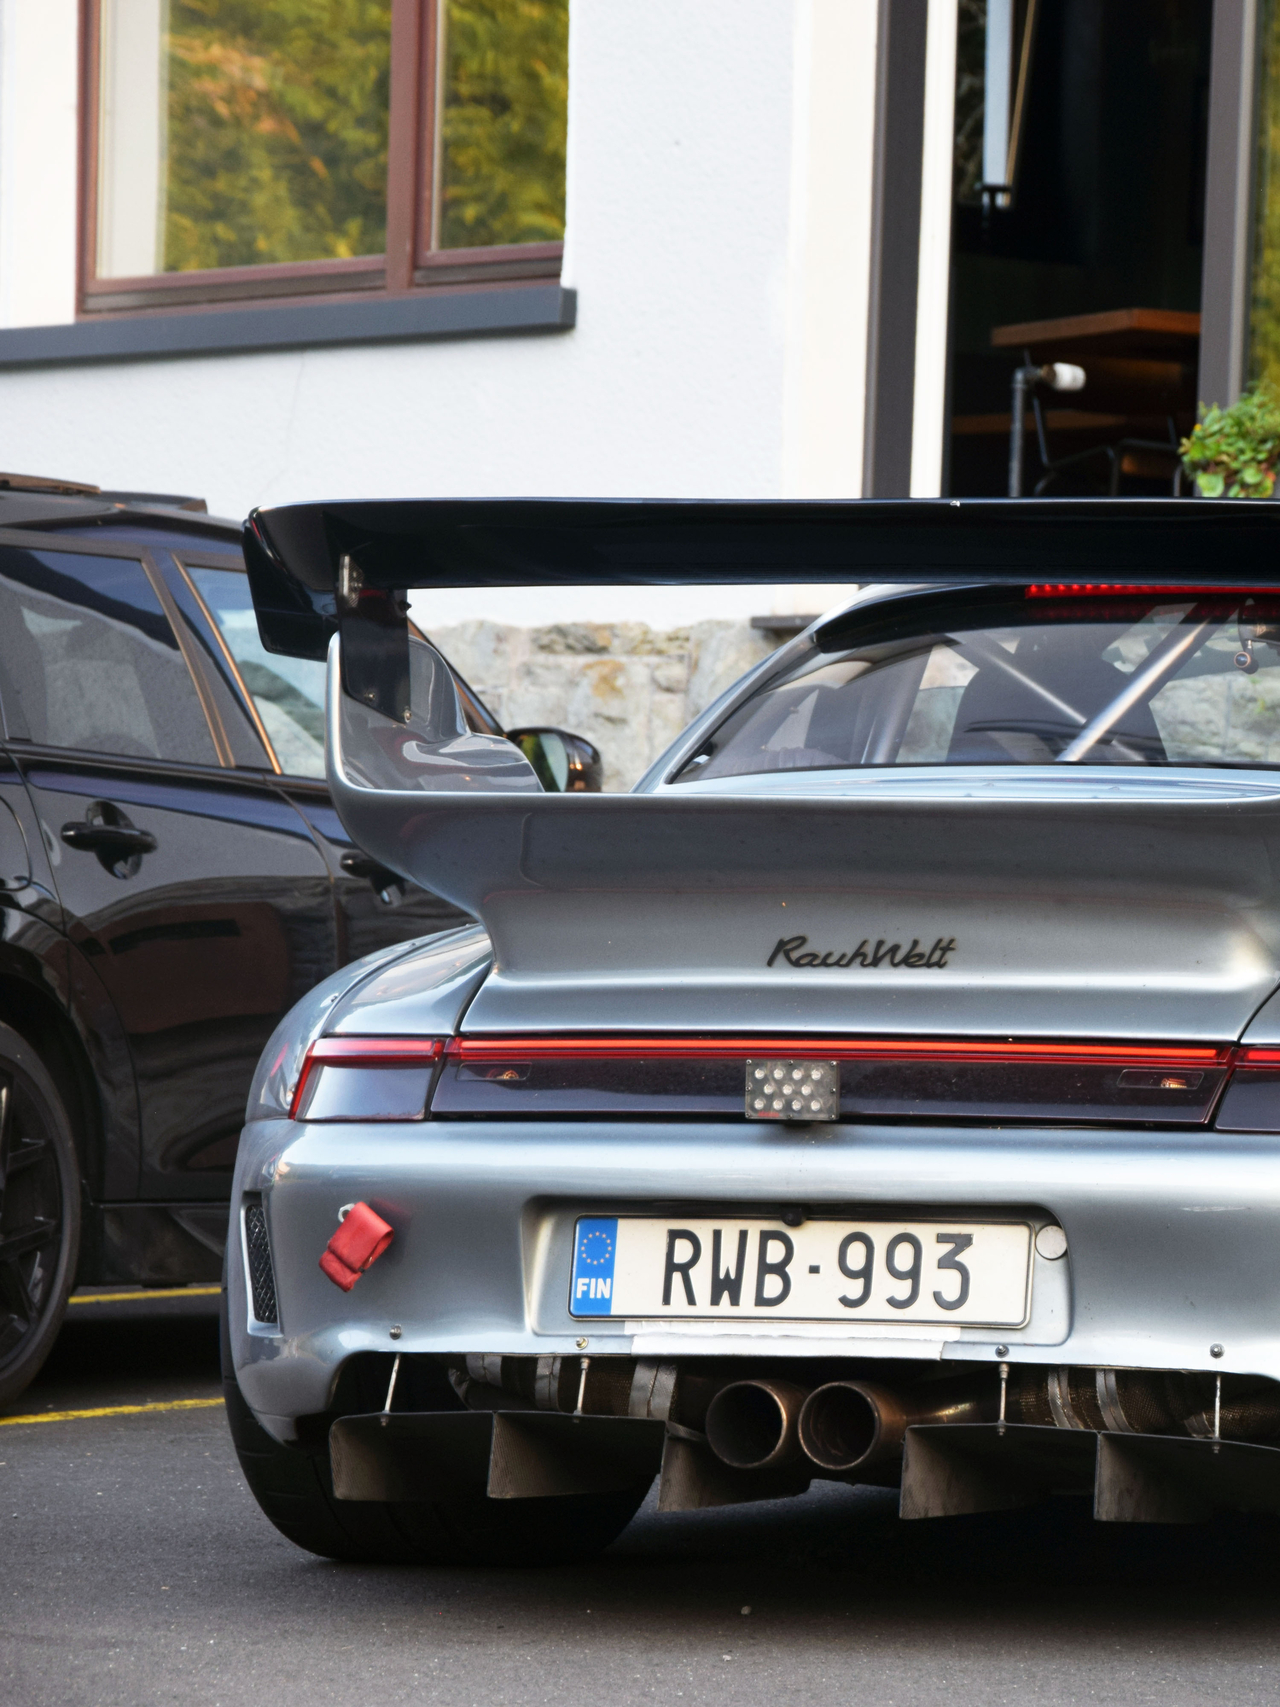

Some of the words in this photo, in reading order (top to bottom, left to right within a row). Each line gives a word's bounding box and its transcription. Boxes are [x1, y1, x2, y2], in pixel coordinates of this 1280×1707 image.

[766, 935, 957, 969] RauhWelt
[661, 1228, 976, 1312] RWB-993
[576, 1277, 612, 1299] FIN
